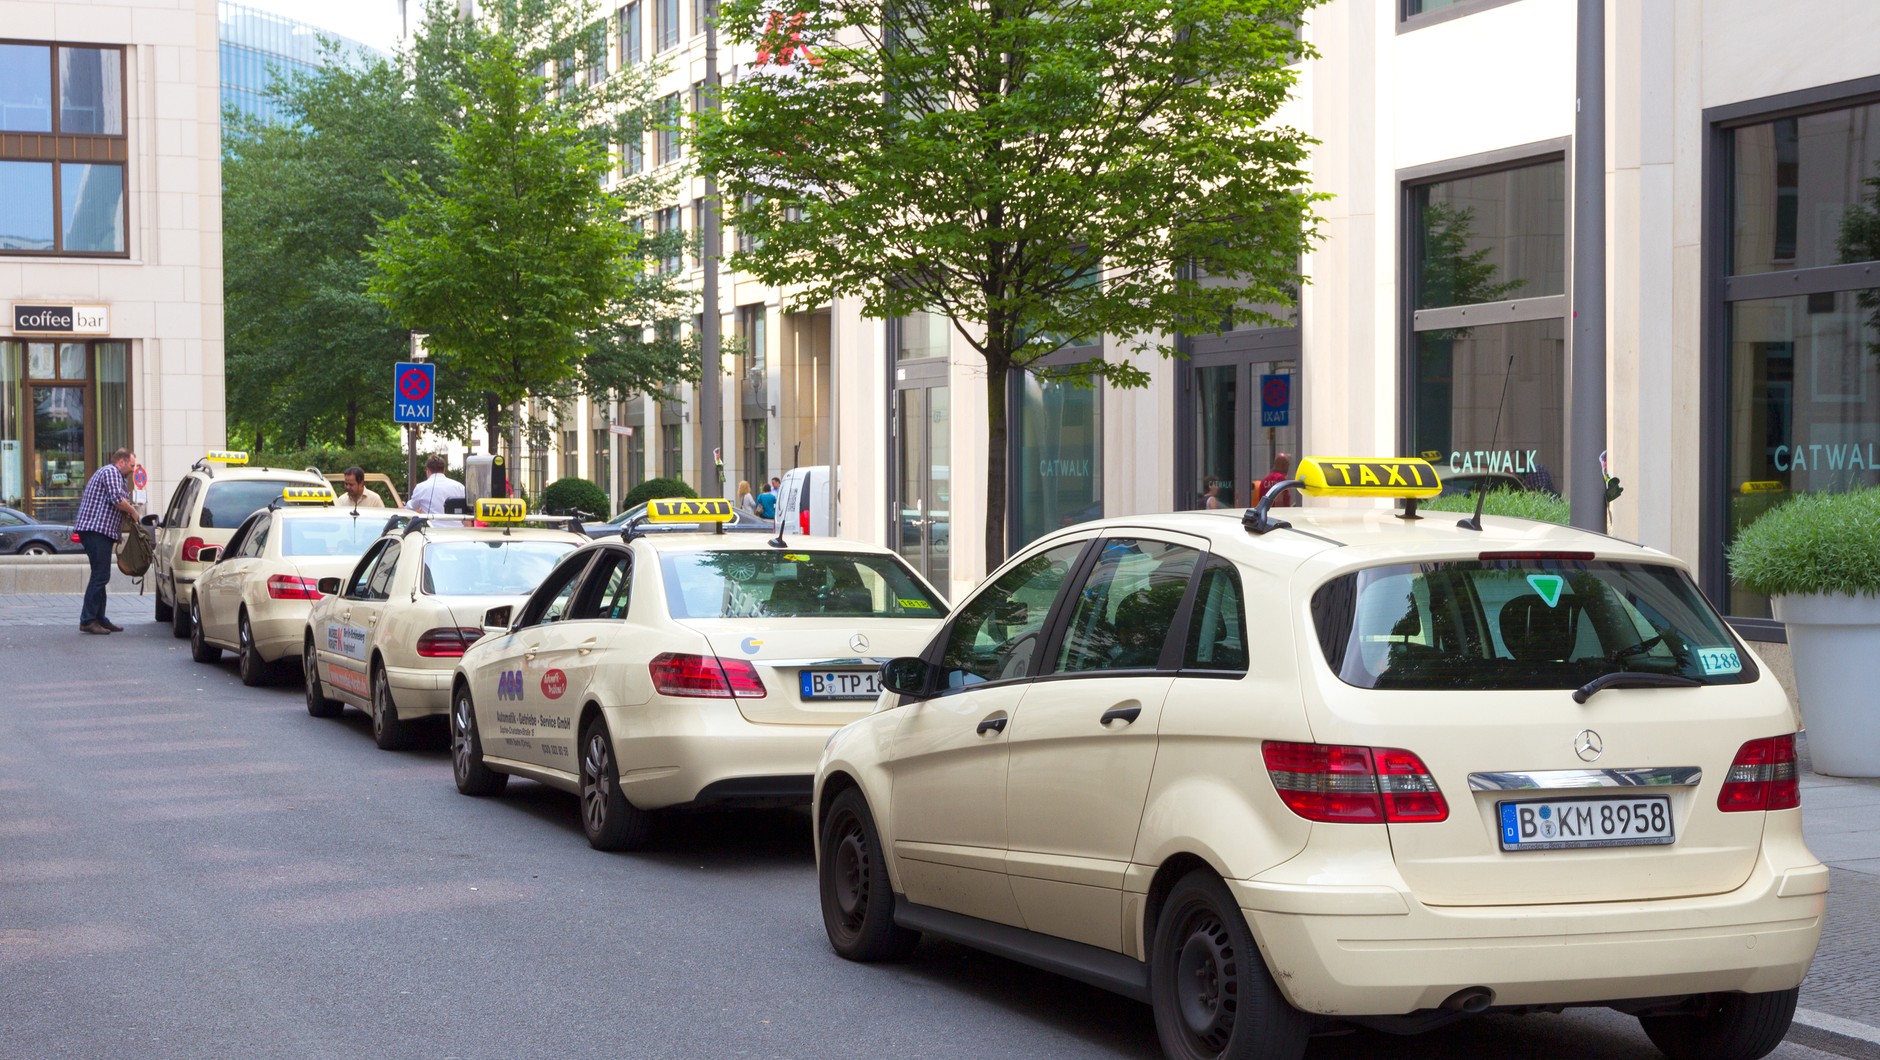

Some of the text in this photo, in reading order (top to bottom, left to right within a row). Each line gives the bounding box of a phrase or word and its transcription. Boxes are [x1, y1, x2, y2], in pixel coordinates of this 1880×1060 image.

[20, 310, 104, 327] coffee bar
[398, 404, 430, 418] TAXI
[1040, 460, 1089, 476] CATWALK
[1450, 450, 1537, 474] CATWALK
[1332, 464, 1422, 486] TAXI
[1208, 480, 1232, 488] CATWALK
[294, 488, 327, 497] TAXI
[486, 504, 519, 518] TAXI
[664, 502, 722, 514] TAXI
[1702, 652, 1741, 670] 1288
[812, 675, 825, 692] B
[838, 675, 860, 692] TP
[496, 711, 570, 730] Automatik Getriebe Service GmbH
[1520, 802, 1666, 838] B KM 8958
[1508, 828, 1514, 836] D
